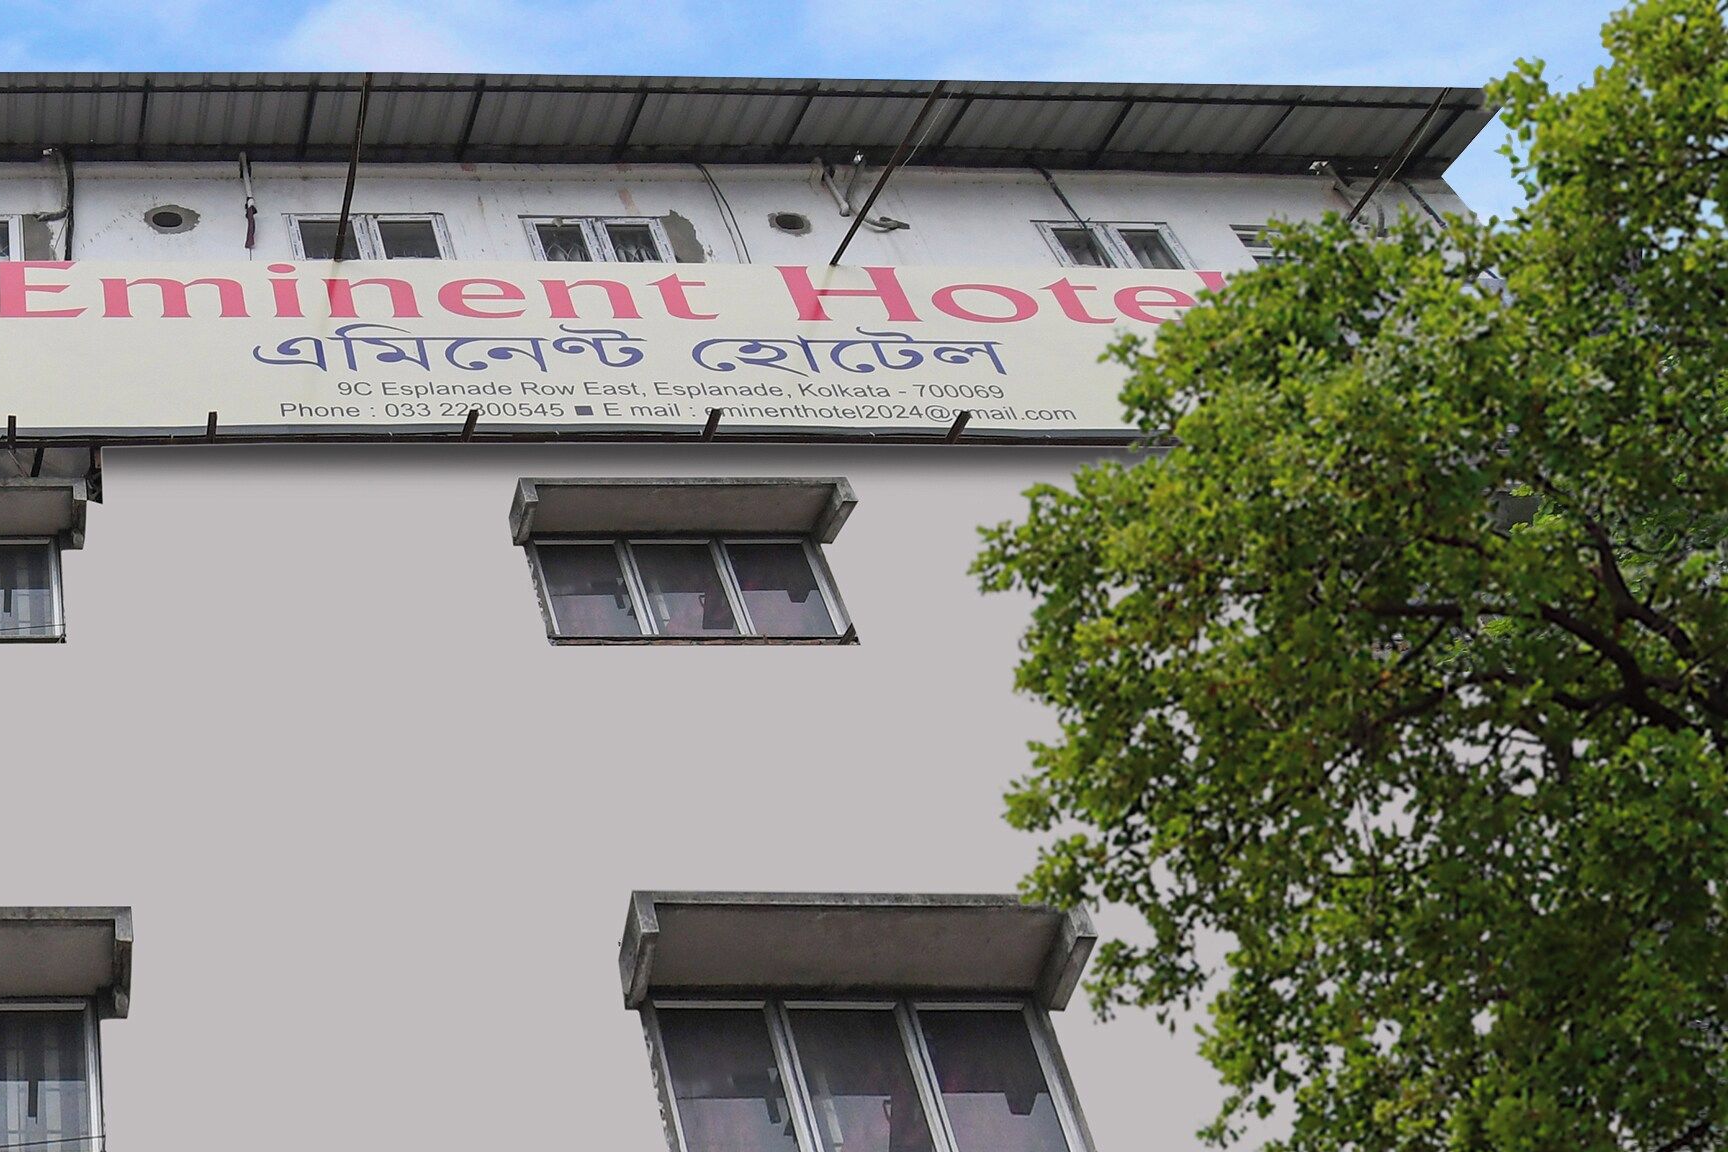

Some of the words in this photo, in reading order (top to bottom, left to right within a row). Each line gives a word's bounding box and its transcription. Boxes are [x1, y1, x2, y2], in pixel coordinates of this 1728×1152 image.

[252, 323, 648, 373] এমিনেন্ট
[691, 326, 1008, 377] হোটেল
[337, 381, 373, 396] 9C
[381, 381, 513, 398] Esplanade
[520, 381, 575, 396] Row
[583, 381, 647, 398] East,
[653, 381, 792, 400] Esplanade,
[797, 383, 891, 398] Kolkata
[913, 384, 1005, 399] 700069
[280, 402, 361, 417] Phone
[384, 402, 431, 417] 033
[439, 402, 565, 417] 22300545
